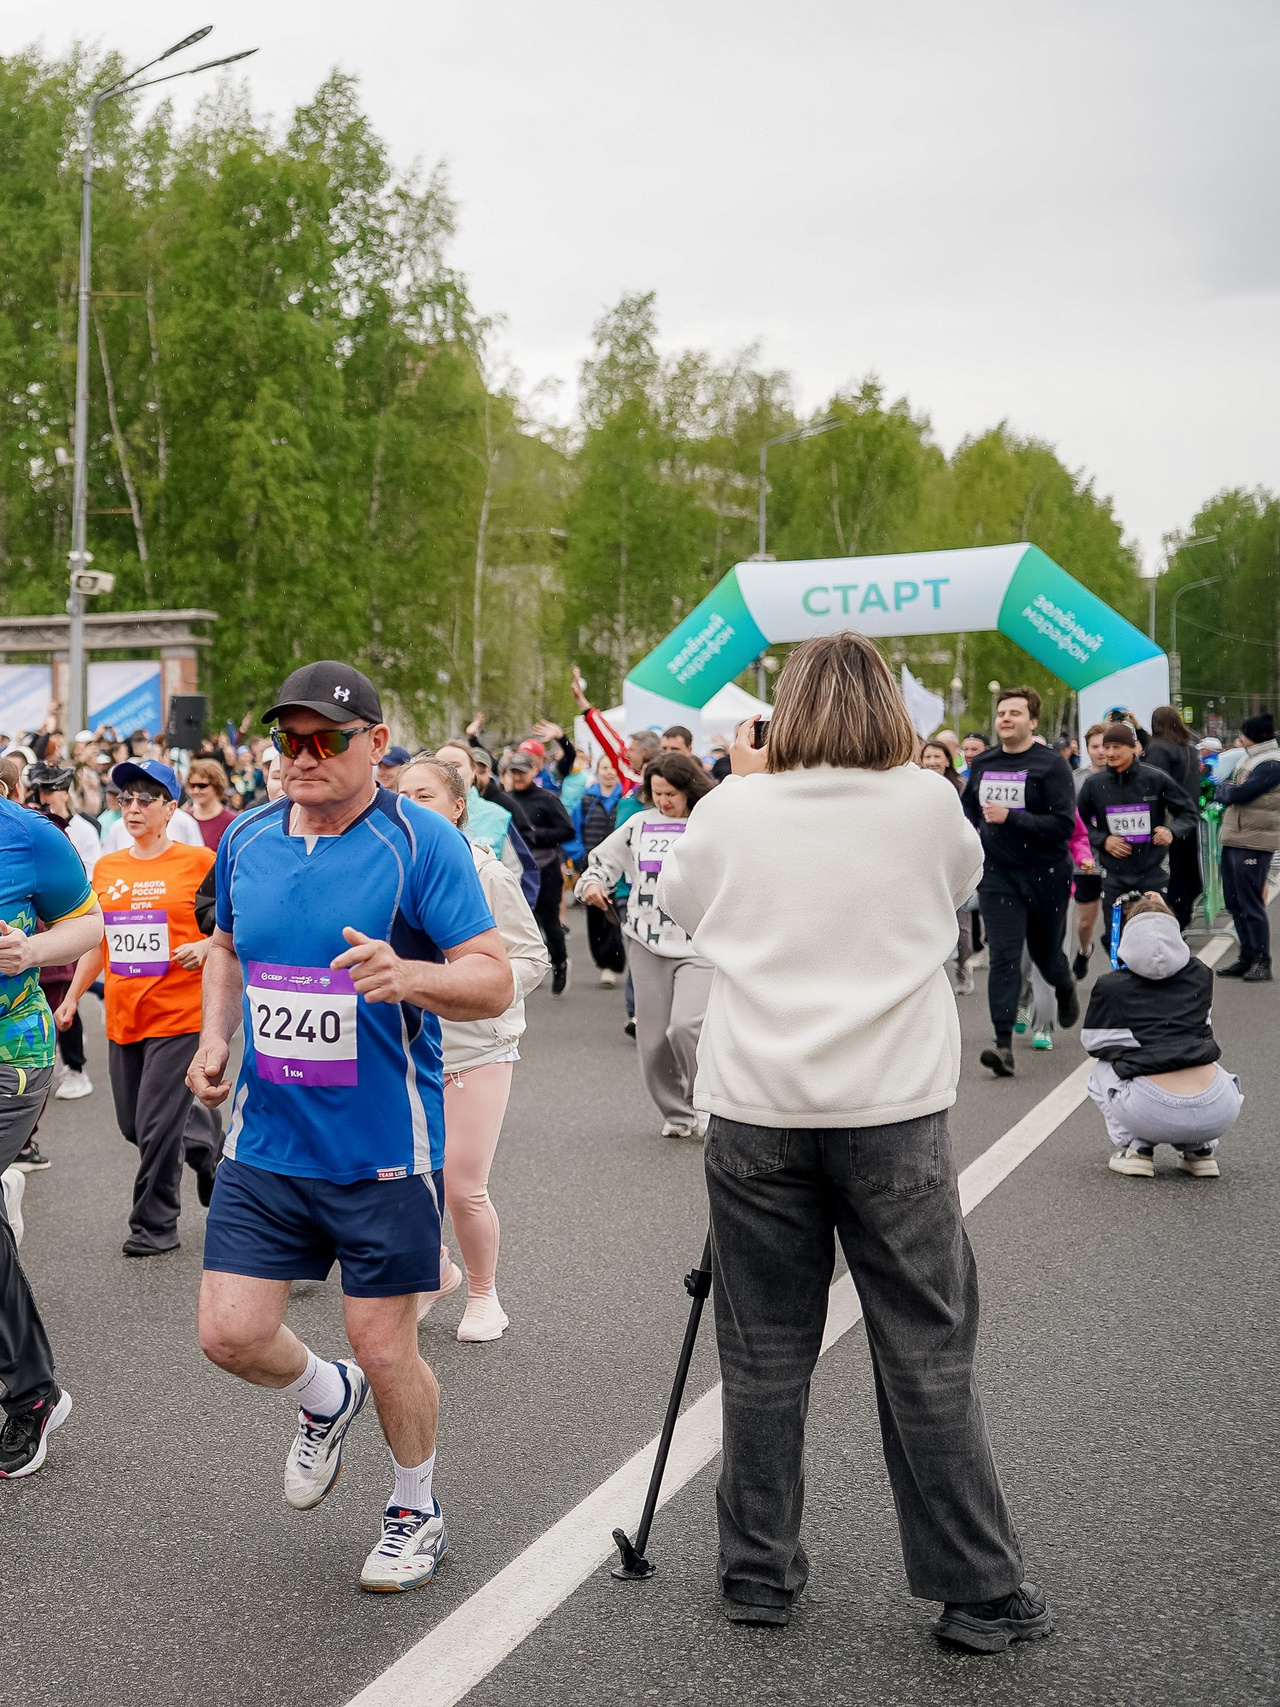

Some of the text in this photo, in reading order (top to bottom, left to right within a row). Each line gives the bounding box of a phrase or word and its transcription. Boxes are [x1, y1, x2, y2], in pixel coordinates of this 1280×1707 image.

[802, 578, 950, 616] СТАРТ
[1022, 606, 1090, 663] марафон
[1033, 594, 1104, 652] зелёный
[667, 612, 725, 674] зелёный
[676, 625, 735, 684] марафон
[986, 787, 1019, 801] 2212
[1114, 817, 1145, 831] 2016
[131, 887, 166, 896] РОССИИ
[133, 881, 165, 889] РАБОТА
[131, 901, 152, 910] ЮГРА
[113, 933, 161, 952] 2045
[257, 1004, 340, 1043] 2240
